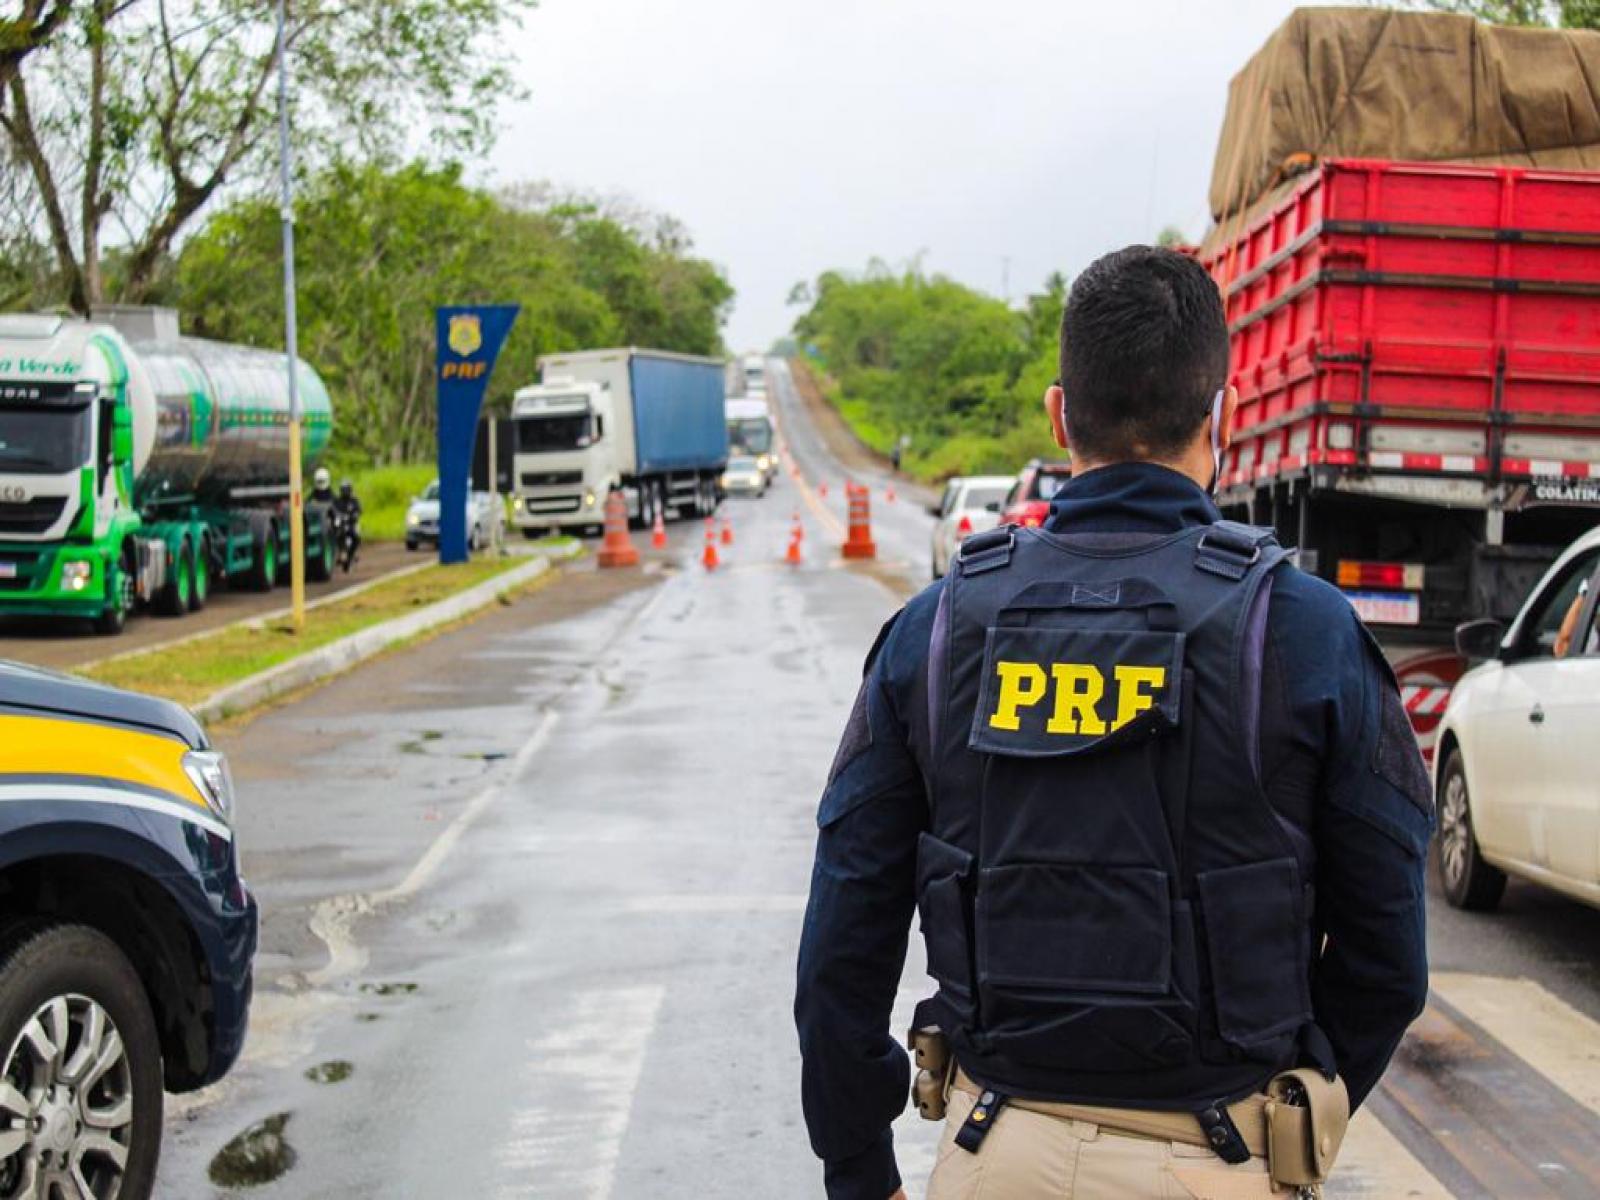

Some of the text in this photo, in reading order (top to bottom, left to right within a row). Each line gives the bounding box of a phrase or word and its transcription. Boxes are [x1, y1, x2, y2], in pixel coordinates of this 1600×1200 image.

[18, 358, 82, 374] Verde
[442, 362, 486, 378] PRF
[0, 486, 26, 501] CO
[1536, 486, 1600, 501] COLATIN
[989, 661, 1166, 736] PRF
